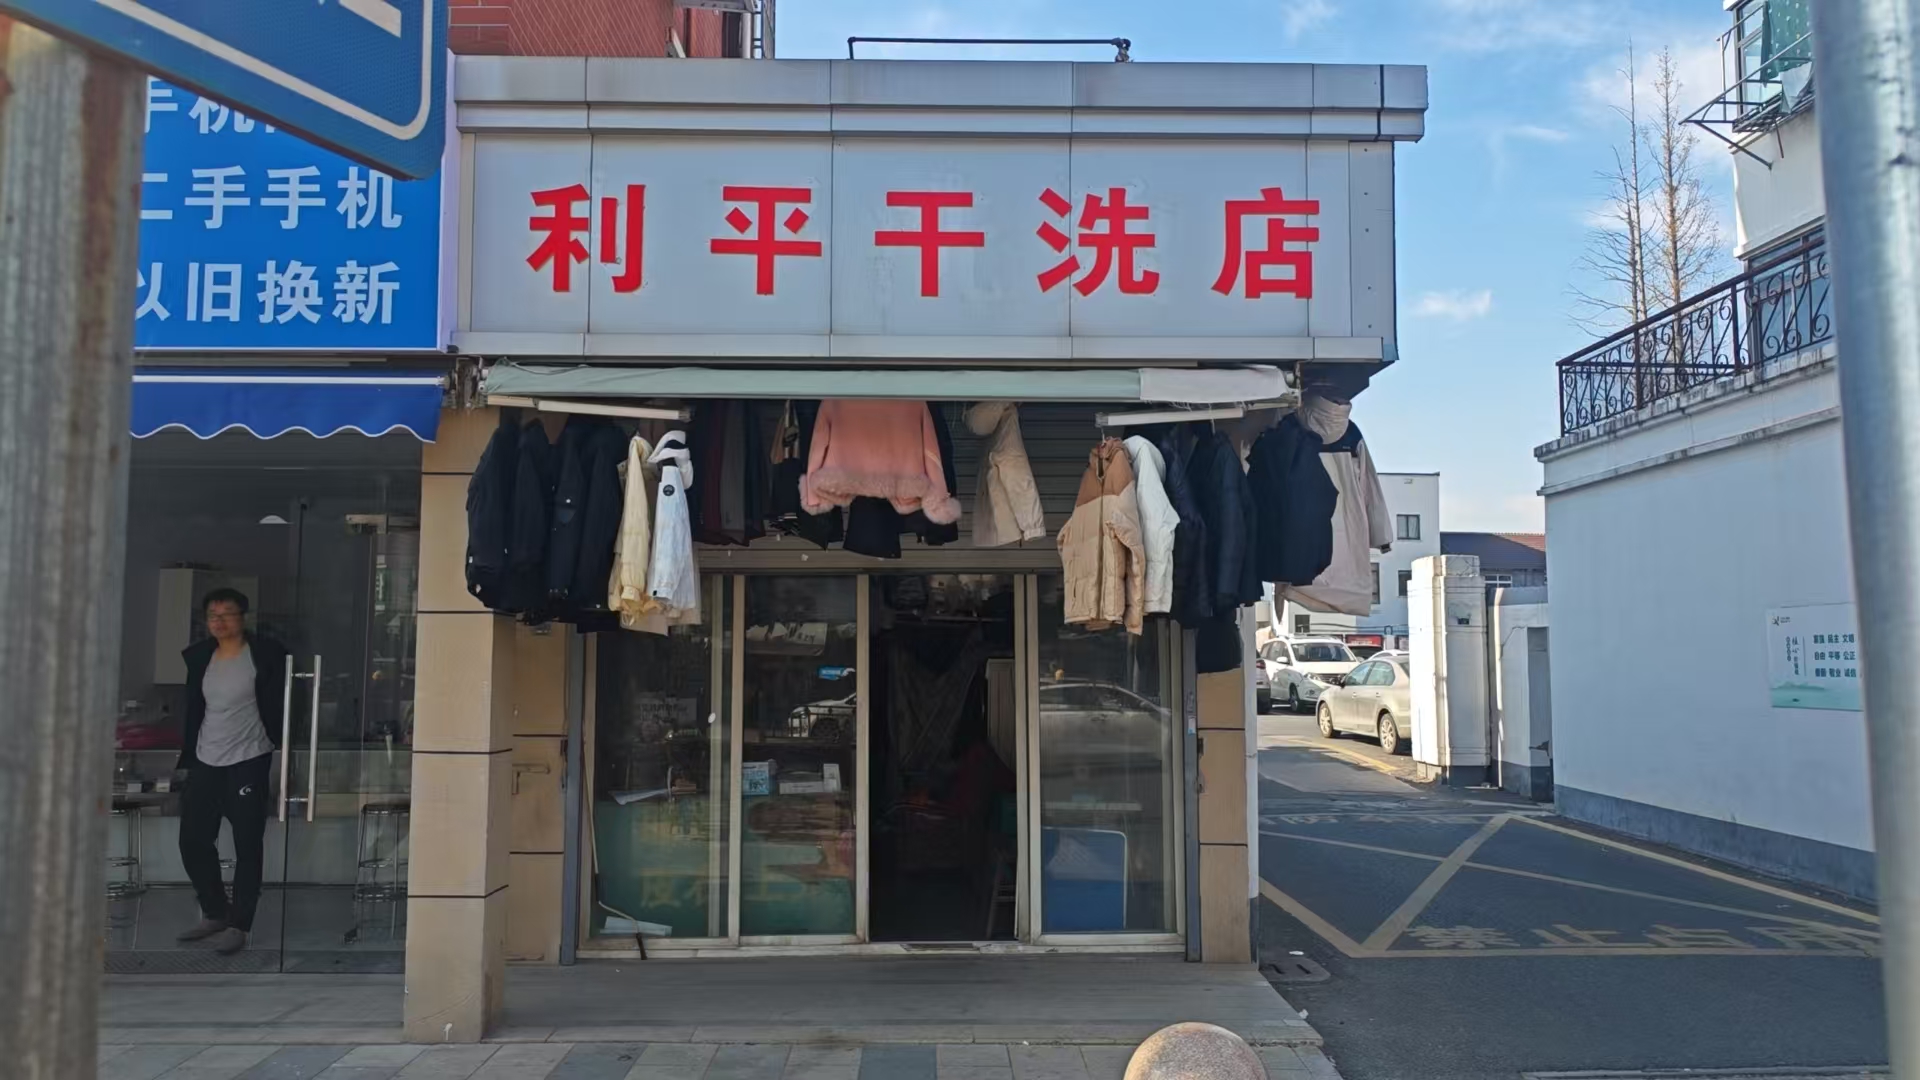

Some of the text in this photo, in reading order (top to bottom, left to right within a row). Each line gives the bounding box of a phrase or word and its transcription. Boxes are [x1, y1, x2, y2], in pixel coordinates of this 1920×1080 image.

[139, 165, 403, 230] 二手手机
[526, 183, 1321, 300] 利平干洗店
[135, 260, 401, 325] 以旧换新
